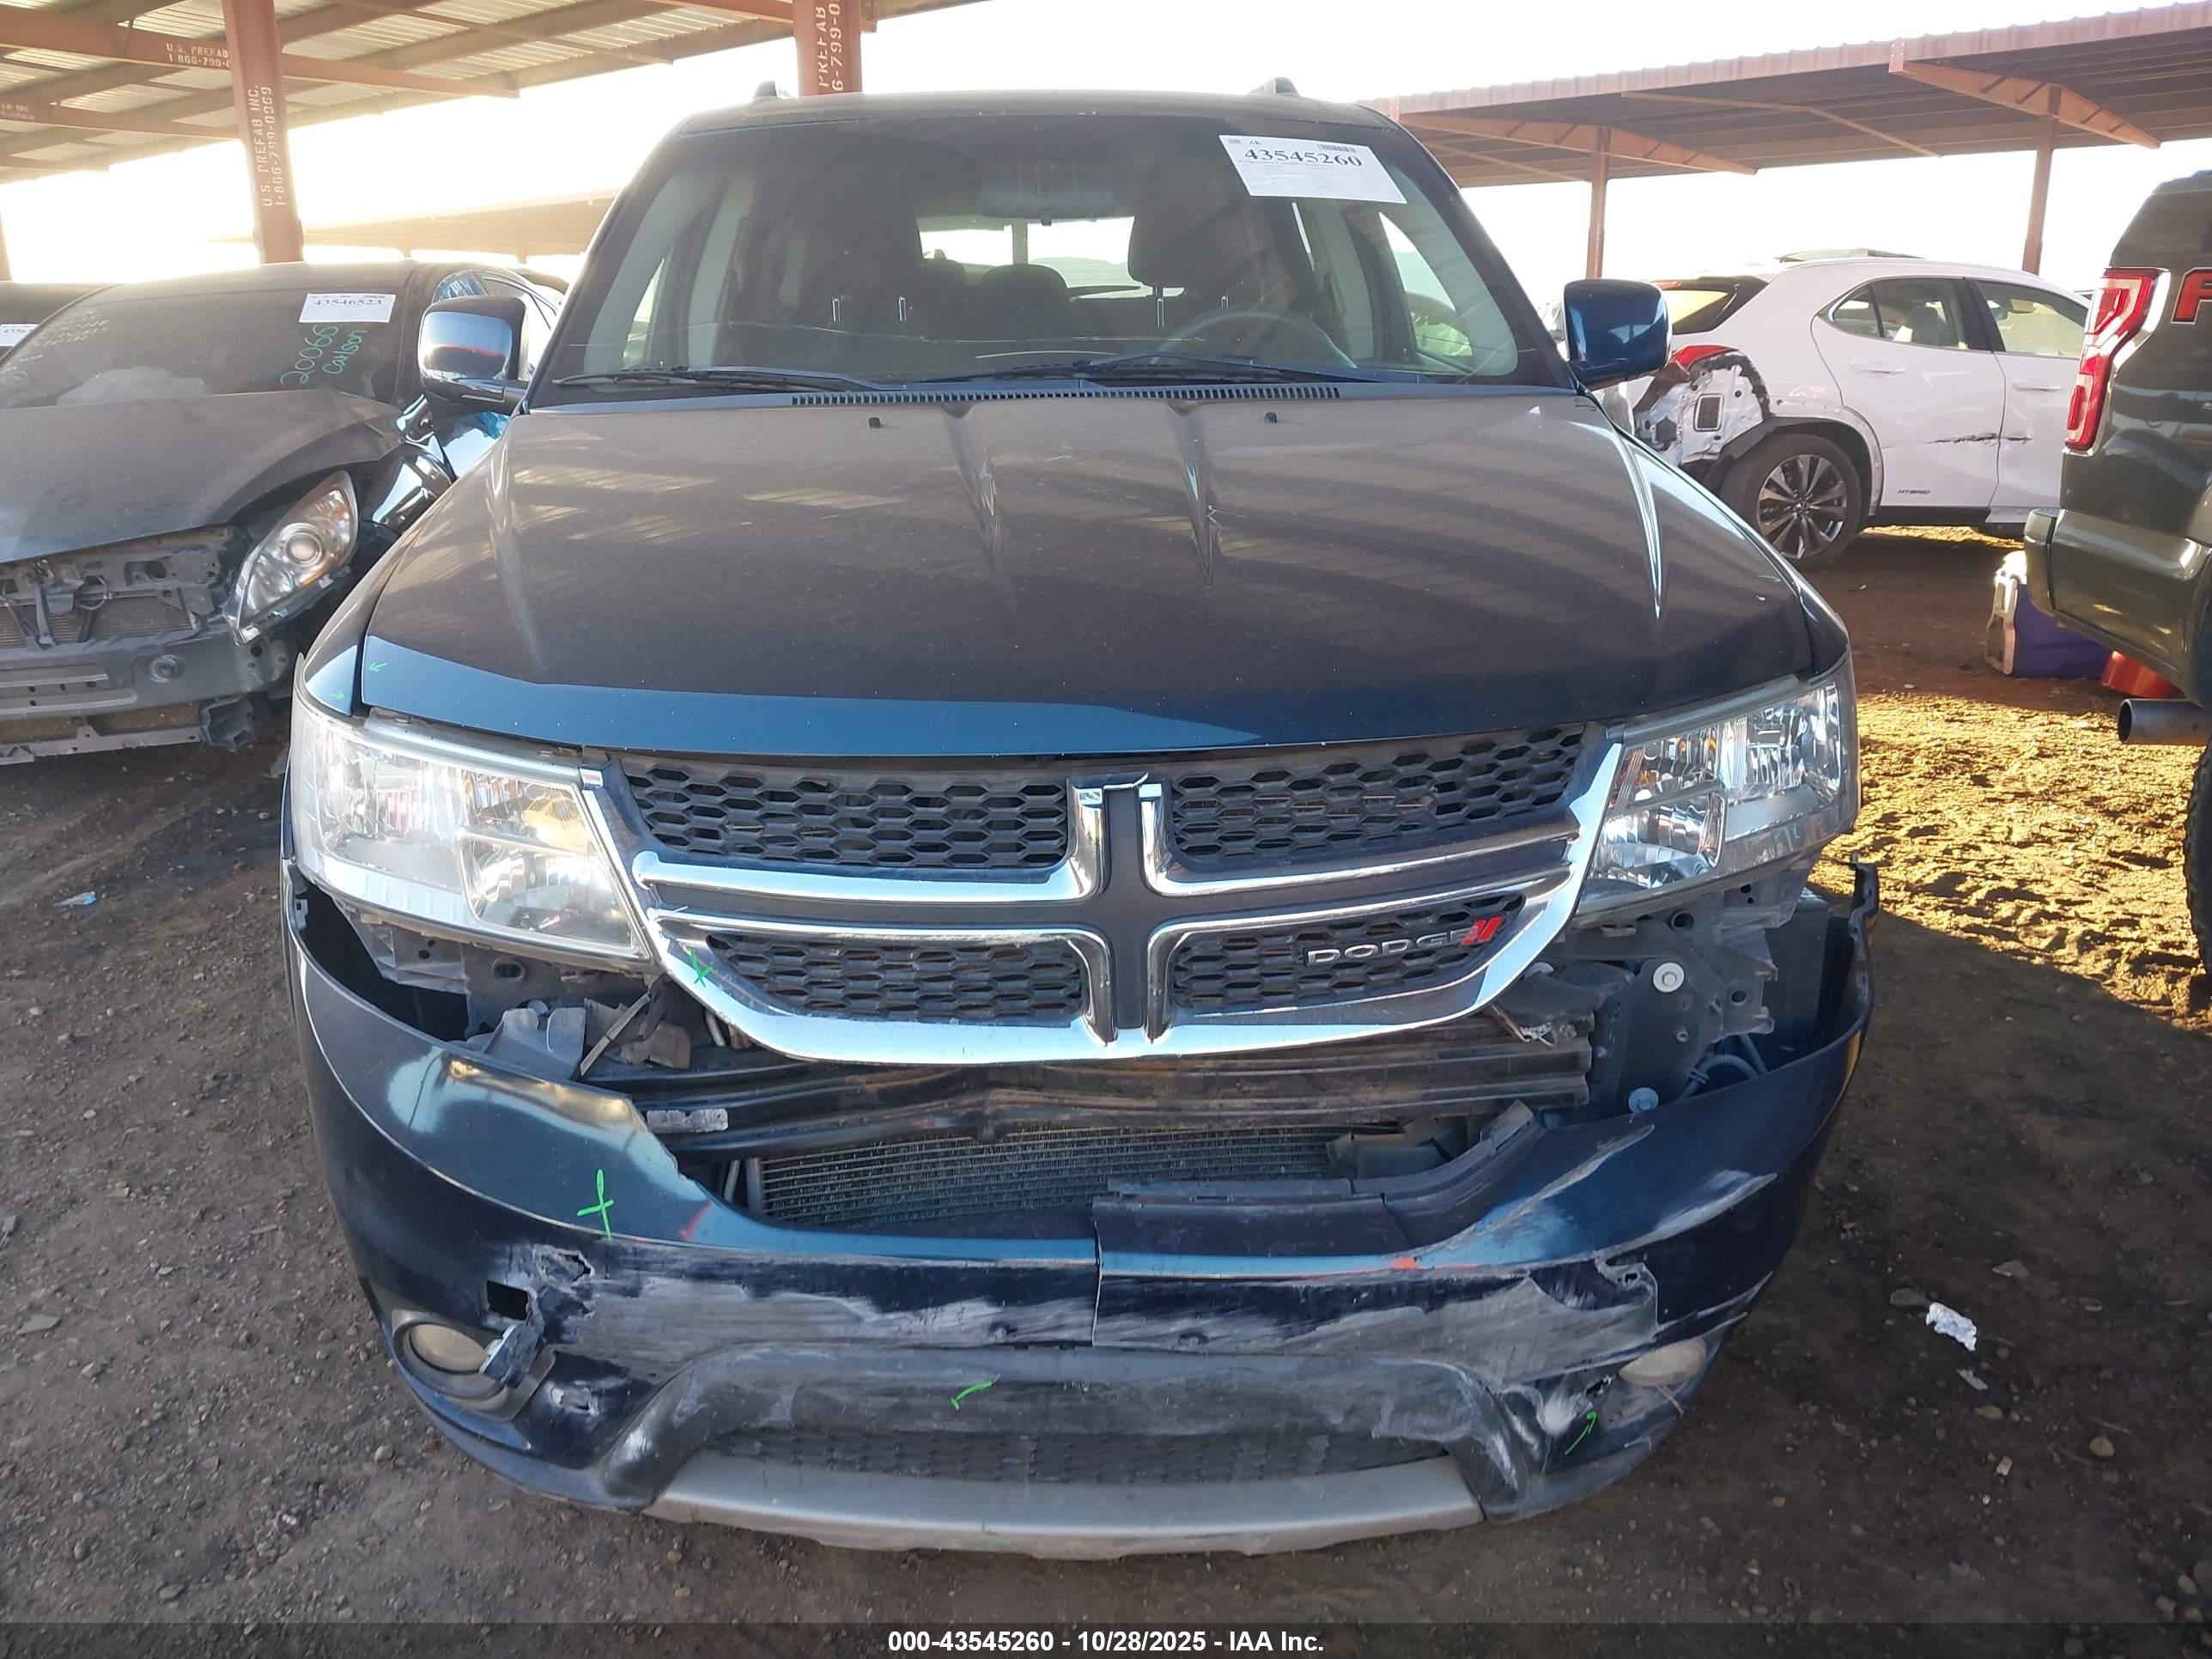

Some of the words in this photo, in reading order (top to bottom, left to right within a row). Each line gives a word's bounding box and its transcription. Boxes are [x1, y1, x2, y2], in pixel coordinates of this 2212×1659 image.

[191, 46, 229, 58] PREFAB
[815, 6, 830, 88] PREFAB
[247, 84, 261, 111] INC.
[251, 118, 269, 173] PREFAB
[1244, 148, 1363, 167] 43545260
[260, 180, 274, 207] U.S.
[280, 324, 339, 385] 20066
[1306, 928, 1470, 965] DODGE
